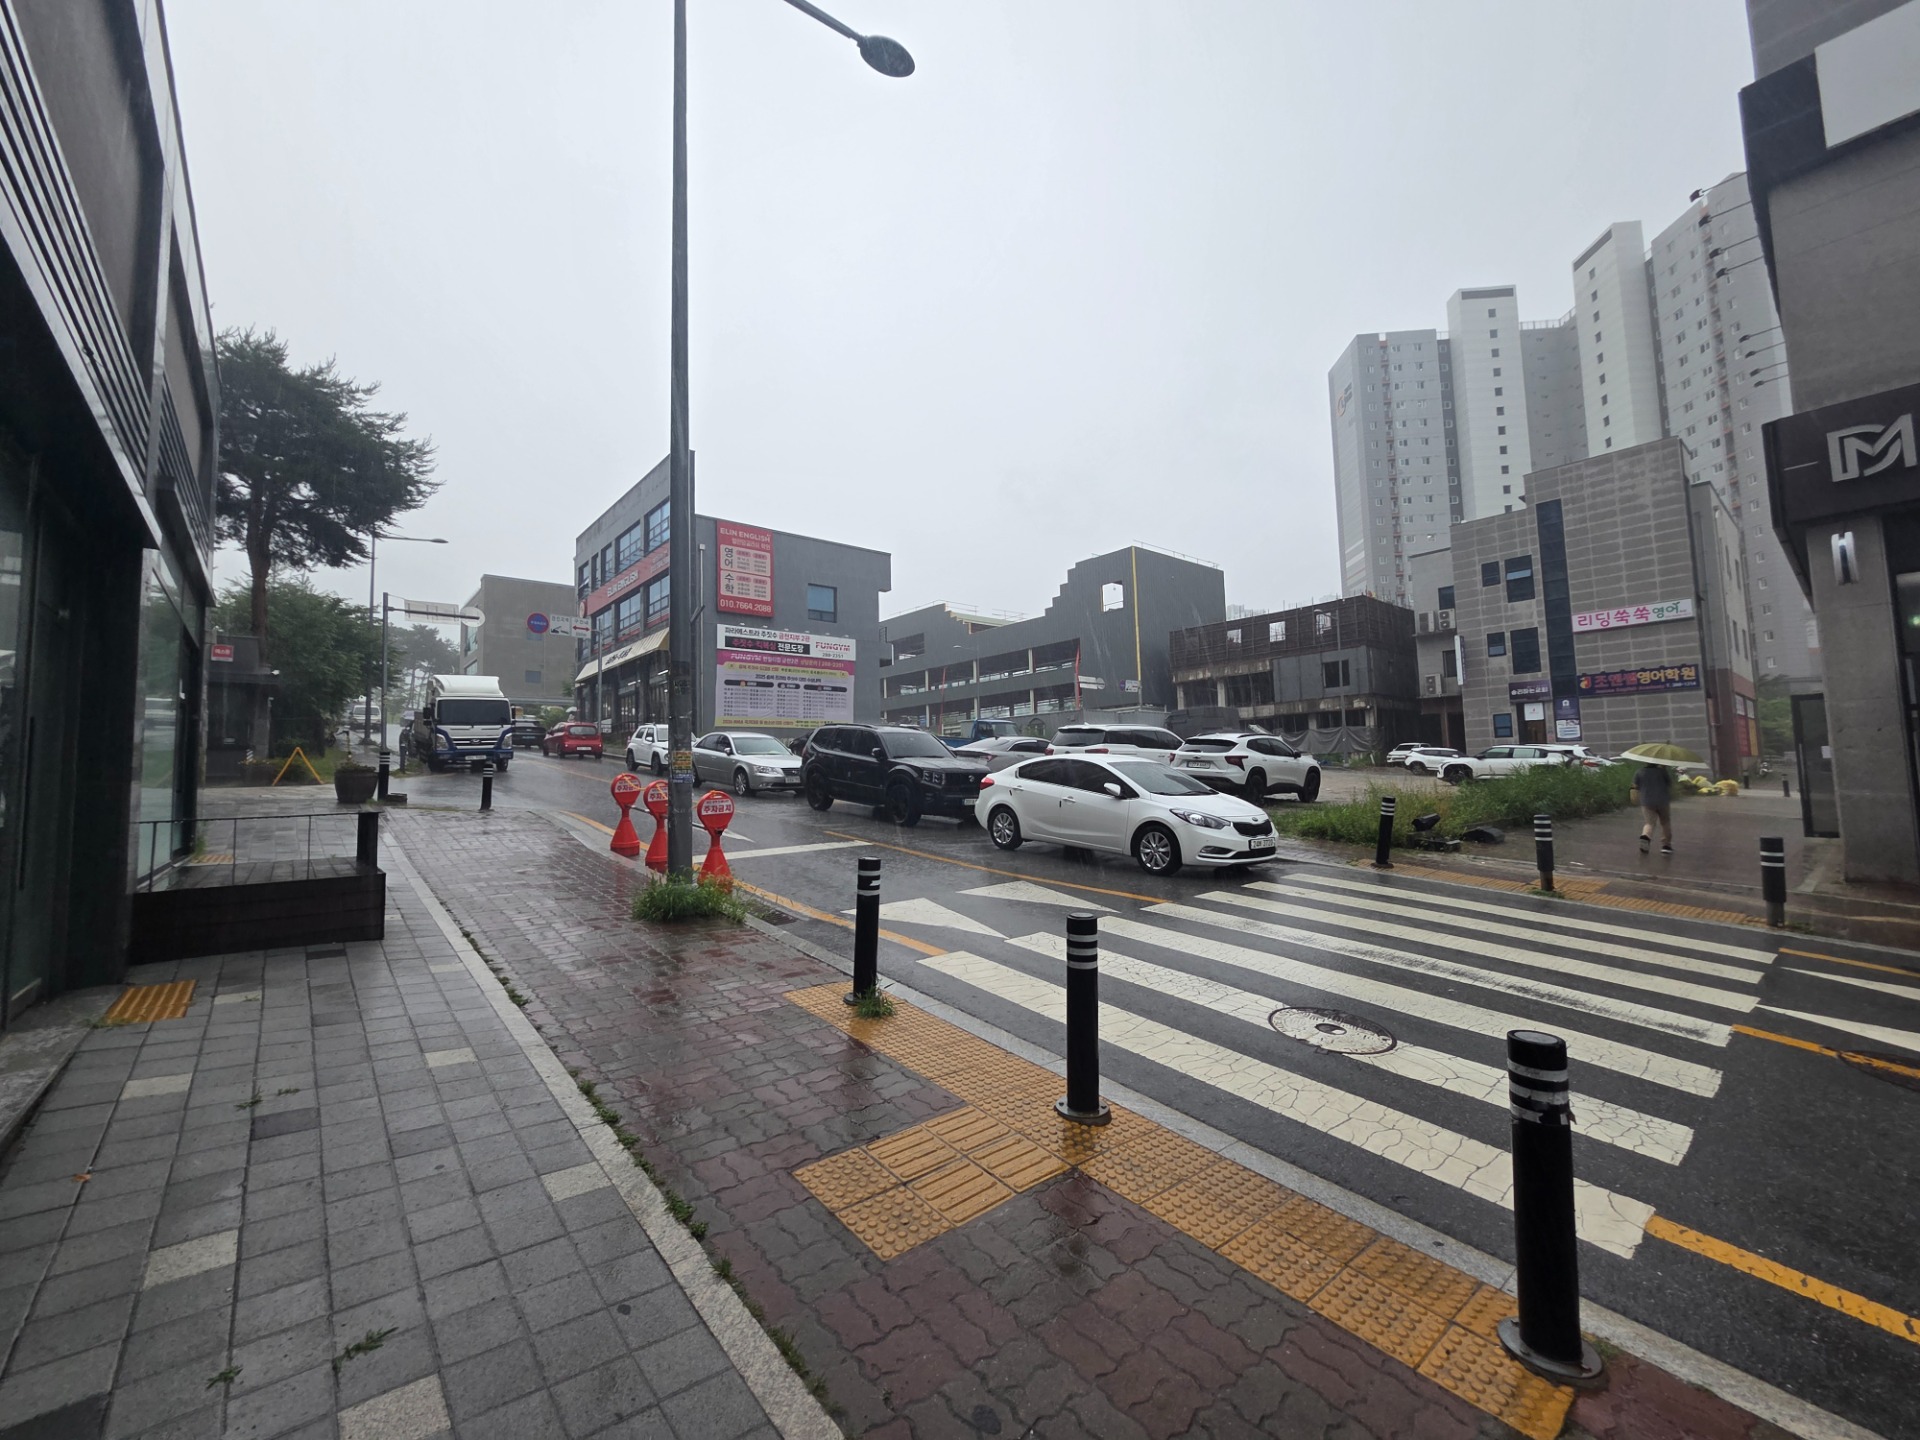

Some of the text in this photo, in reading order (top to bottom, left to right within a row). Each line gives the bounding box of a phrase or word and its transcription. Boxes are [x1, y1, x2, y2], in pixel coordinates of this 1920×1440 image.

[720, 527, 771, 543] ELIN ENGLISH
[761, 630, 778, 639] 주짓수
[732, 639, 754, 648] 주짓수
[777, 643, 804, 653] 전문도장
[815, 641, 850, 652] FUNGYM
[730, 653, 762, 662] FUNGYM
